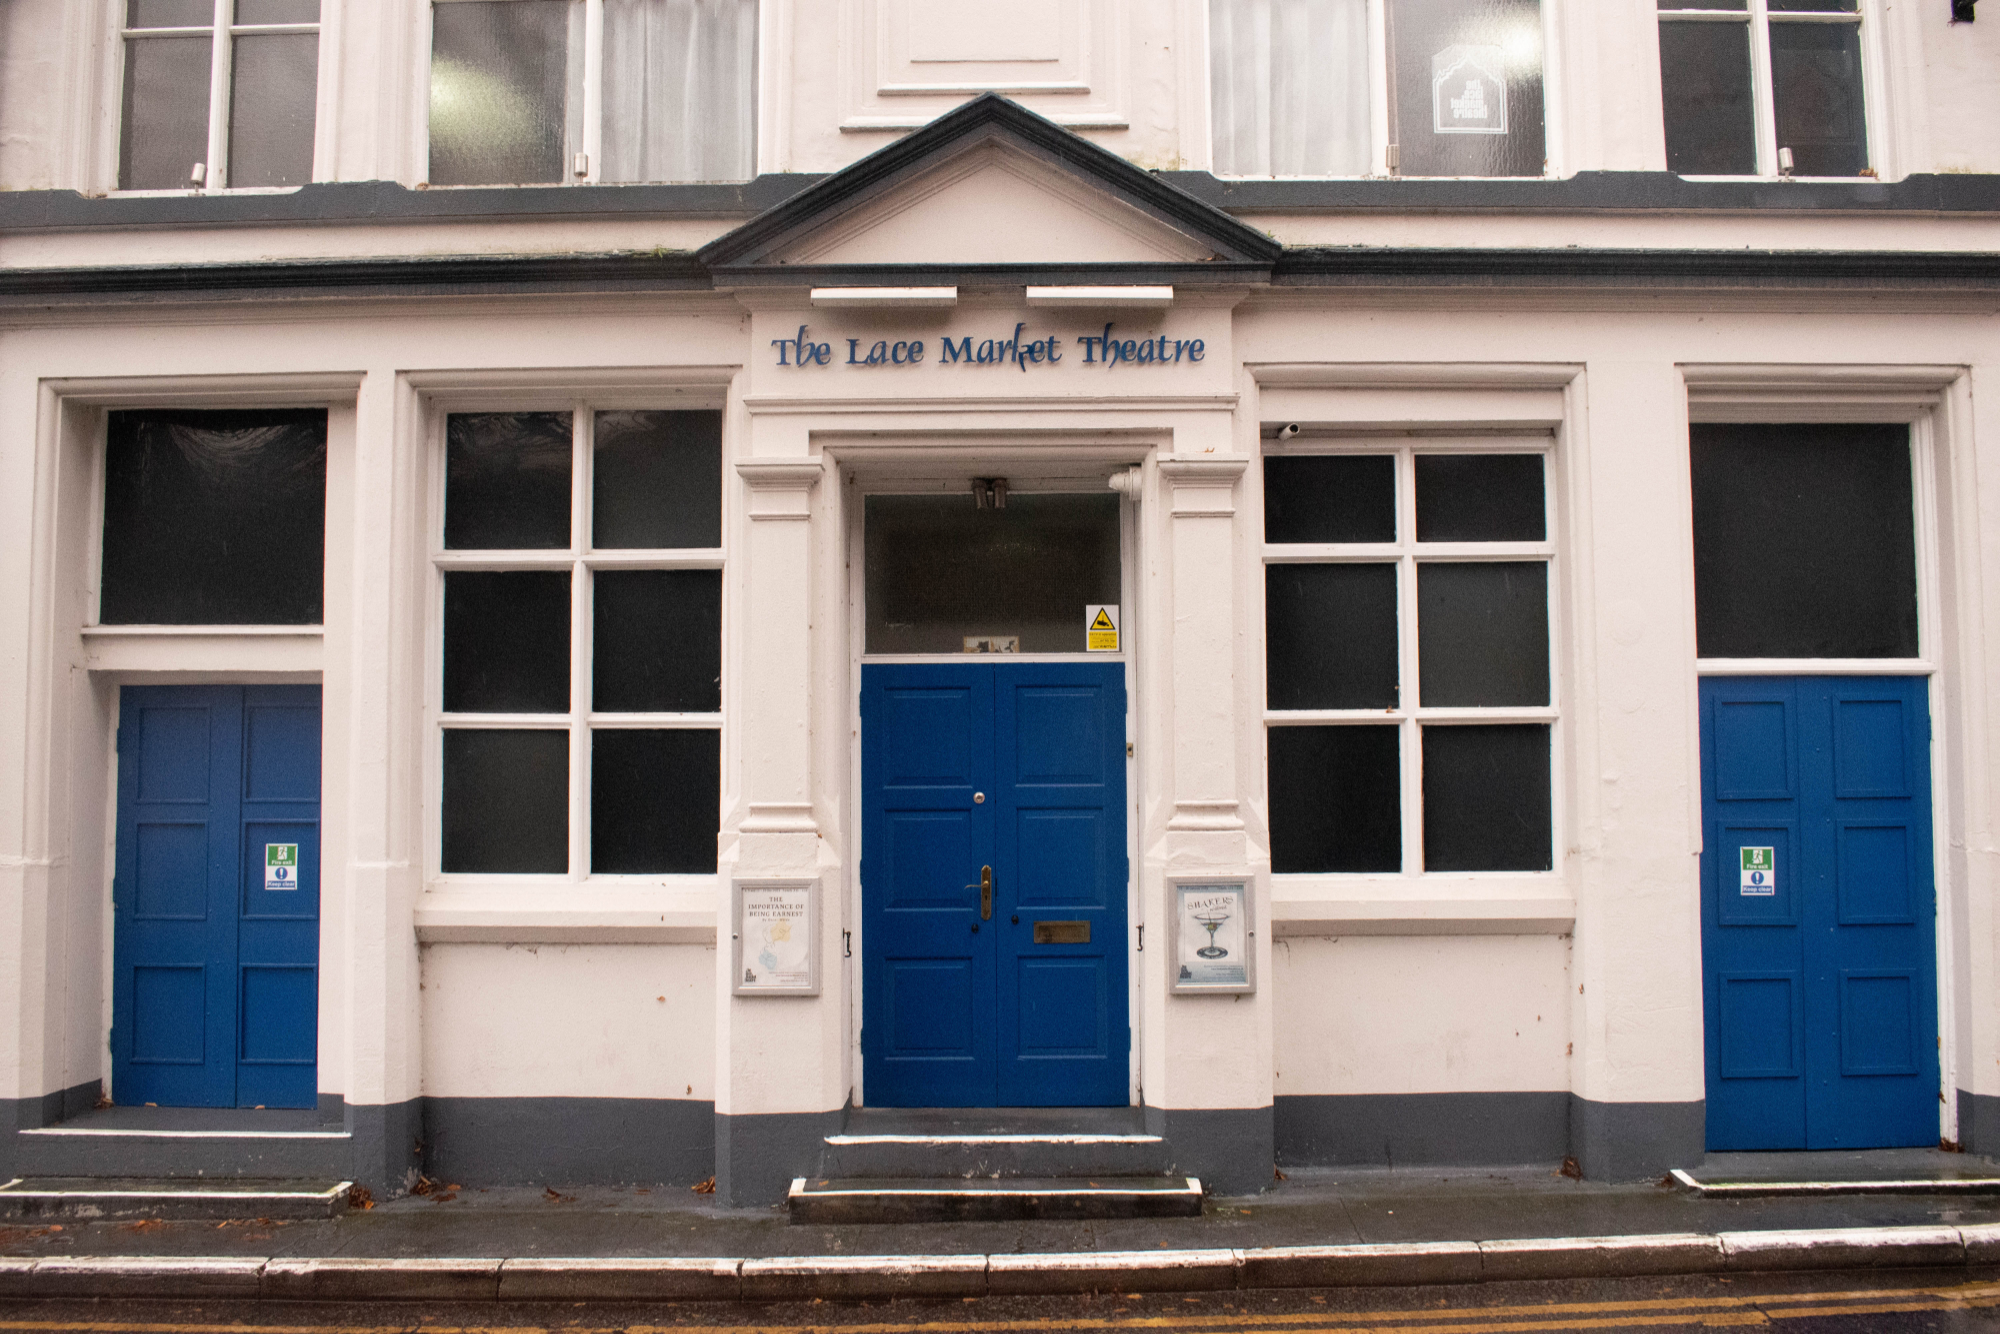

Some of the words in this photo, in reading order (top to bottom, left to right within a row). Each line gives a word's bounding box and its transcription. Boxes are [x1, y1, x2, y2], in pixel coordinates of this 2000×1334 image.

[771, 325, 831, 367] The
[845, 339, 924, 366] Lace
[939, 323, 1062, 372] Market
[1077, 323, 1206, 368] Theatre
[1187, 896, 1233, 911] SHAKERS
